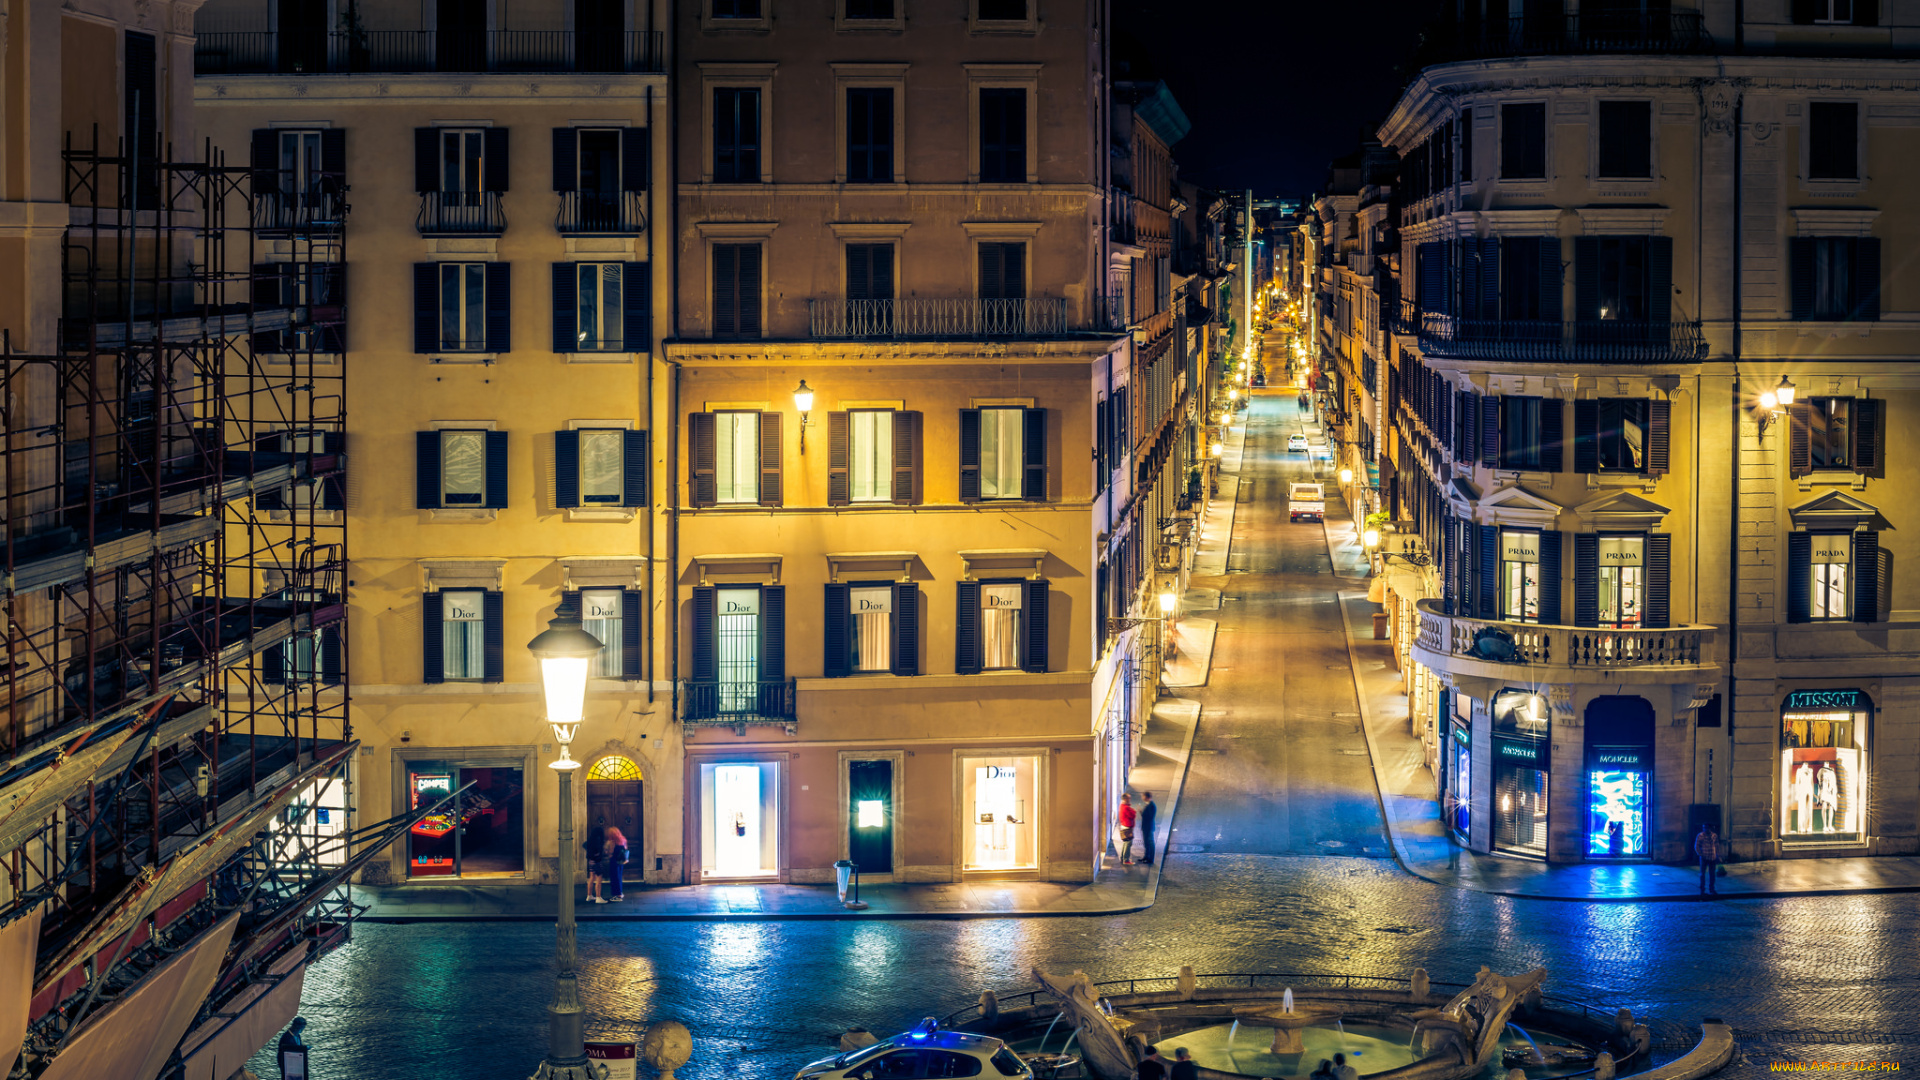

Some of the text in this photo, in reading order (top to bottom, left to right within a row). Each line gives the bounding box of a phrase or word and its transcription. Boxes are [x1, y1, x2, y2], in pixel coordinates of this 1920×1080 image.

[1507, 547, 1536, 556] PRADA
[1605, 552, 1637, 560] PRADA
[1815, 550, 1845, 558] PRADA
[726, 601, 751, 613] Dior
[859, 599, 884, 611] Dior
[989, 595, 1014, 607] Dior
[452, 607, 476, 619] Dior
[591, 606, 615, 617] Dior
[1790, 692, 1860, 708] MISSONI
[1502, 746, 1536, 759] MONCLER
[1599, 755, 1639, 764] MONCLER
[986, 765, 1016, 778] Dior
[585, 1048, 607, 1058] OMA
